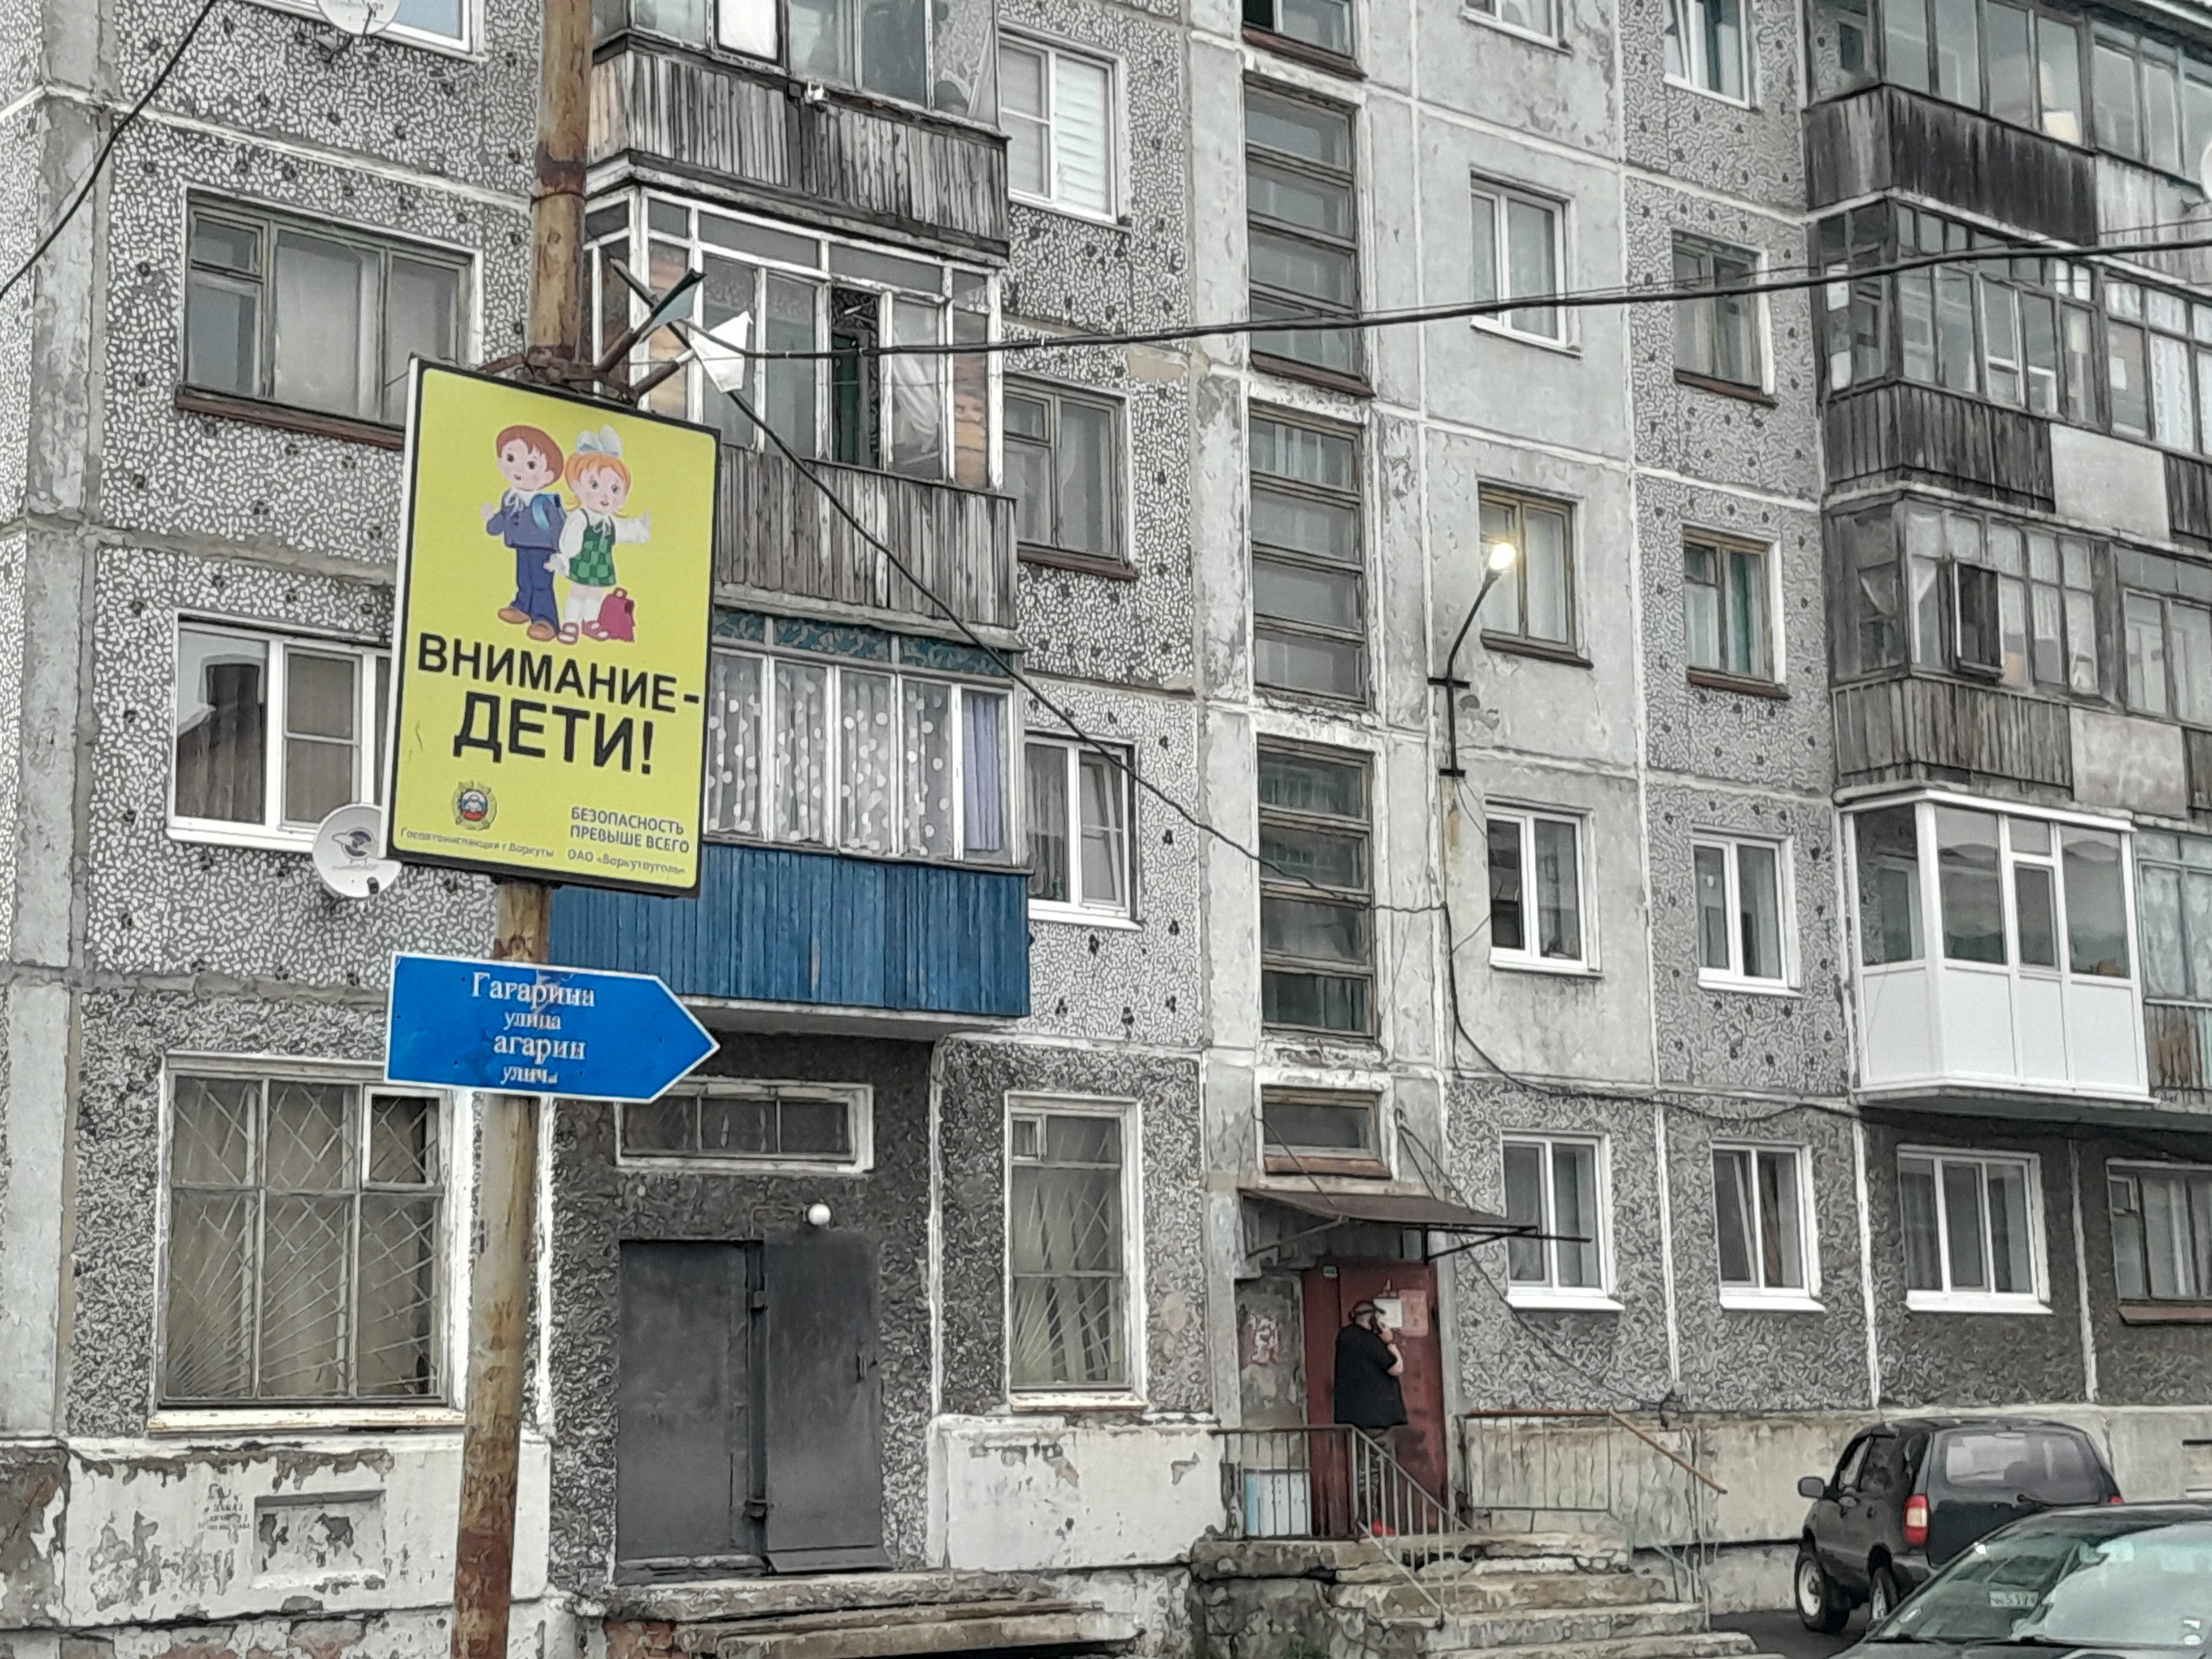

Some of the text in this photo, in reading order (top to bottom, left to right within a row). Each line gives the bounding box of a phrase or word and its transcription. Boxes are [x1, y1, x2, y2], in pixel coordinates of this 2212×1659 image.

[417, 632, 699, 713] ВНИМАНИЕ-
[453, 691, 653, 775] ДЕТИ!
[571, 806, 684, 836] БЕЗОПАСНОСТЬ
[570, 825, 690, 853] ПРЕВЫШЕ ВСЕГО
[568, 849, 594, 862] ОАО
[472, 971, 595, 1010] Гагарина
[503, 1011, 563, 1031] улица
